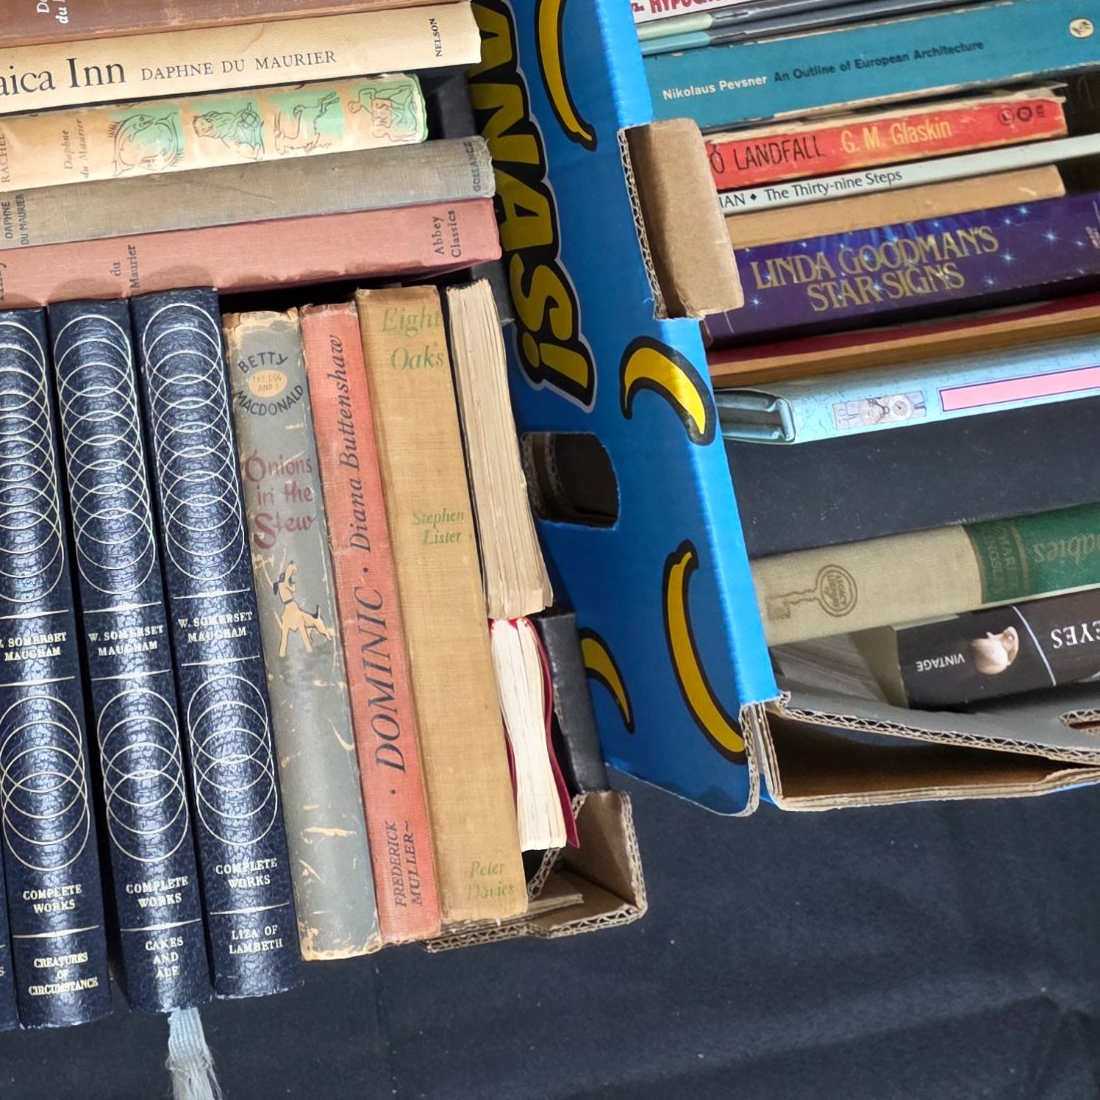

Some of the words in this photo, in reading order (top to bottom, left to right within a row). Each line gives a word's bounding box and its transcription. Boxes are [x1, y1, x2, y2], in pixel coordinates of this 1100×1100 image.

[429, 17, 442, 57] NELSON
[66, 57, 126, 88] Inn
[142, 62, 213, 81] DAPHNE
[222, 60, 244, 74] DU
[256, 50, 337, 70] MAURIER
[662, 81, 715, 101] Nikolaus
[719, 74, 767, 92] Pevsner
[774, 72, 789, 82] An
[793, 63, 836, 80] Outline
[839, 60, 851, 71] of
[854, 52, 910, 72] European
[913, 40, 984, 60] Architecture
[764, 186, 789, 201] The
[792, 174, 863, 198] Thirty-nine
[866, 170, 902, 186] Steps
[431, 216, 444, 255] Abbey
[448, 210, 461, 258] Classics
[751, 252, 834, 290] LINDA
[838, 226, 999, 273] GOODMAN'S
[806, 275, 885, 312] STAR
[887, 263, 965, 299] SIGNS
[381, 308, 441, 338] Eight
[238, 351, 289, 374] BETTY
[390, 346, 444, 370] Oaks
[233, 385, 304, 416] MACDONALD
[326, 335, 360, 471] Buttenshaw
[350, 477, 372, 553] Diana
[916, 653, 965, 672] VINTAGE
[353, 586, 407, 773] DOMINIC
[228, 938, 283, 954] LAMBETH
[232, 928, 258, 941] LIZA
[263, 925, 277, 937] OF
